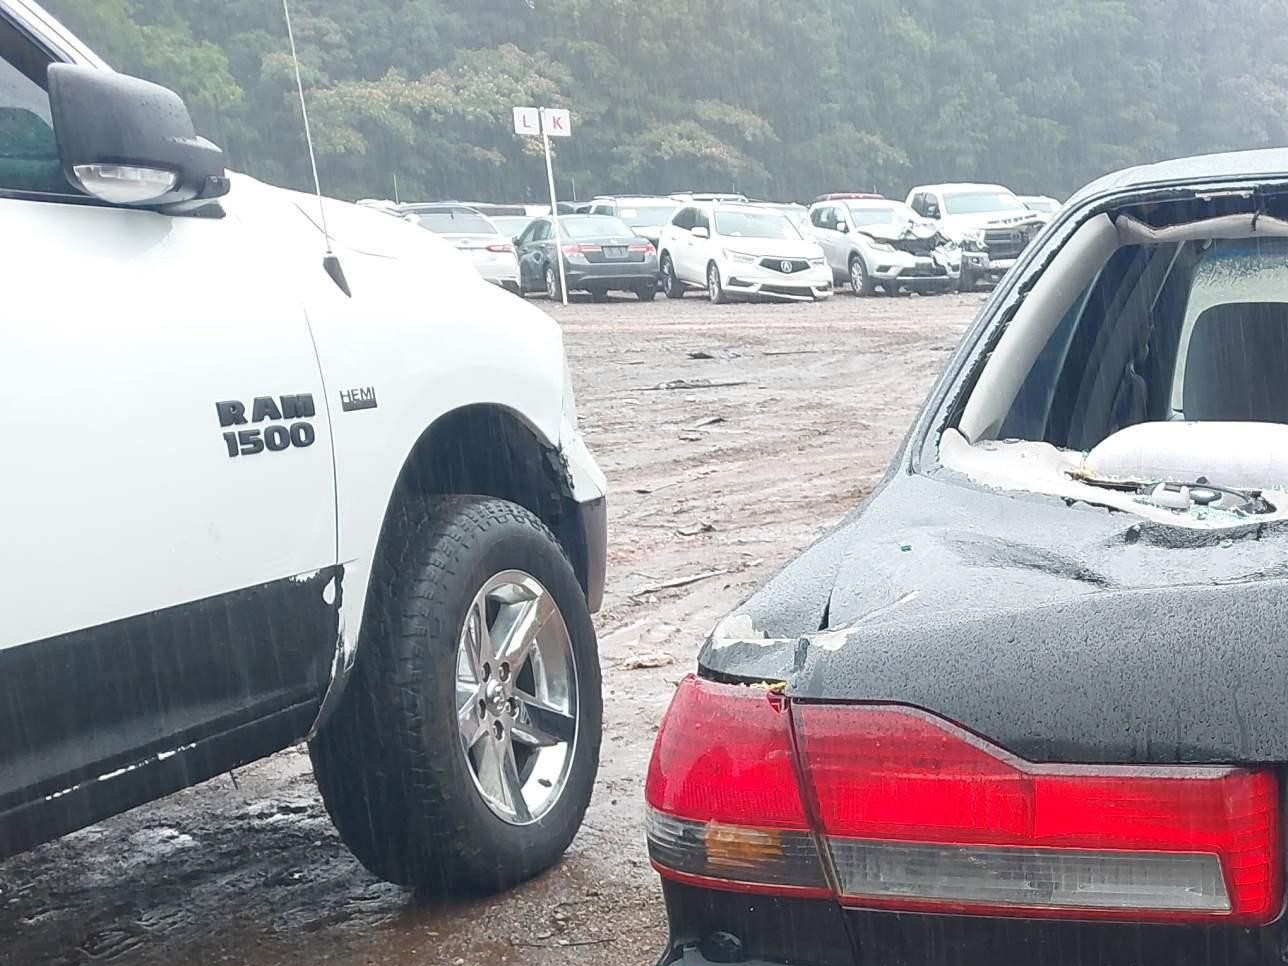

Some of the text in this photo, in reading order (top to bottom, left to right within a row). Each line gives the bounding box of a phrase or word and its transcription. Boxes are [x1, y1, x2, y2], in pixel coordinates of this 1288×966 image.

[522, 114, 532, 128] L
[552, 115, 564, 130] K
[339, 386, 376, 403] HEMI
[215, 392, 316, 427] RAM
[222, 421, 316, 458] 1500
